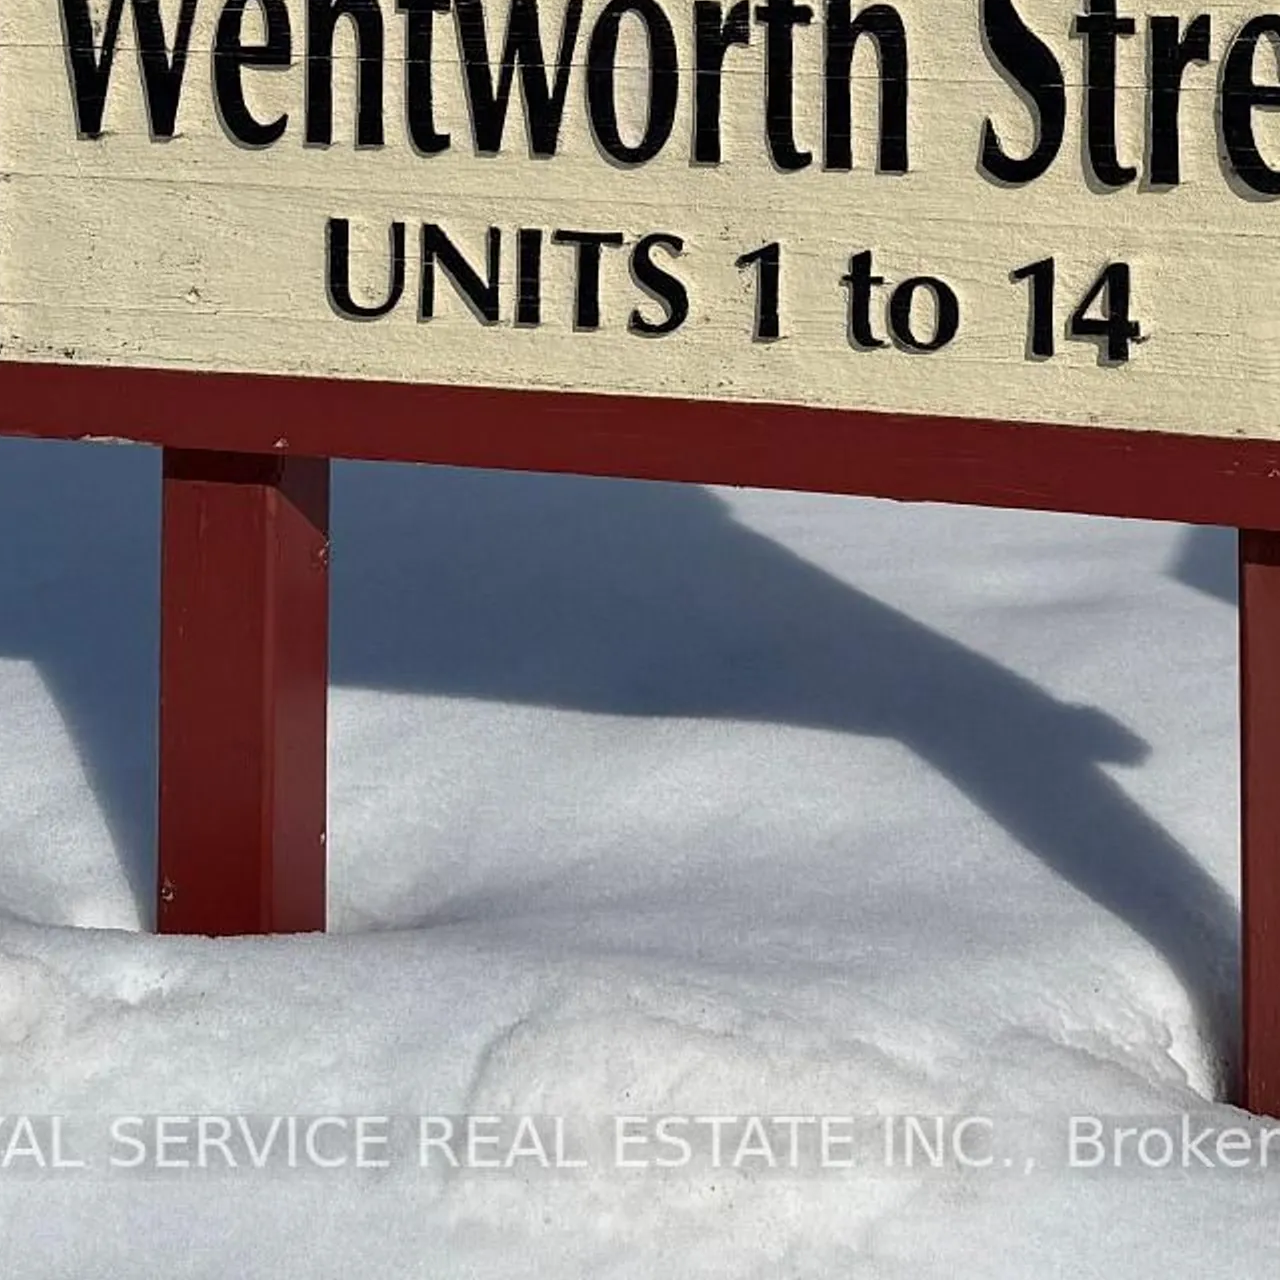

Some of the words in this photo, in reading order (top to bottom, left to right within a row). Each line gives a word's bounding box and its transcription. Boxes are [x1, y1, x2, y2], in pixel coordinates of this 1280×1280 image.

[324, 217, 689, 339] UNITS
[734, 242, 780, 344] 1
[841, 249, 959, 352] to
[1011, 256, 1149, 363] 14
